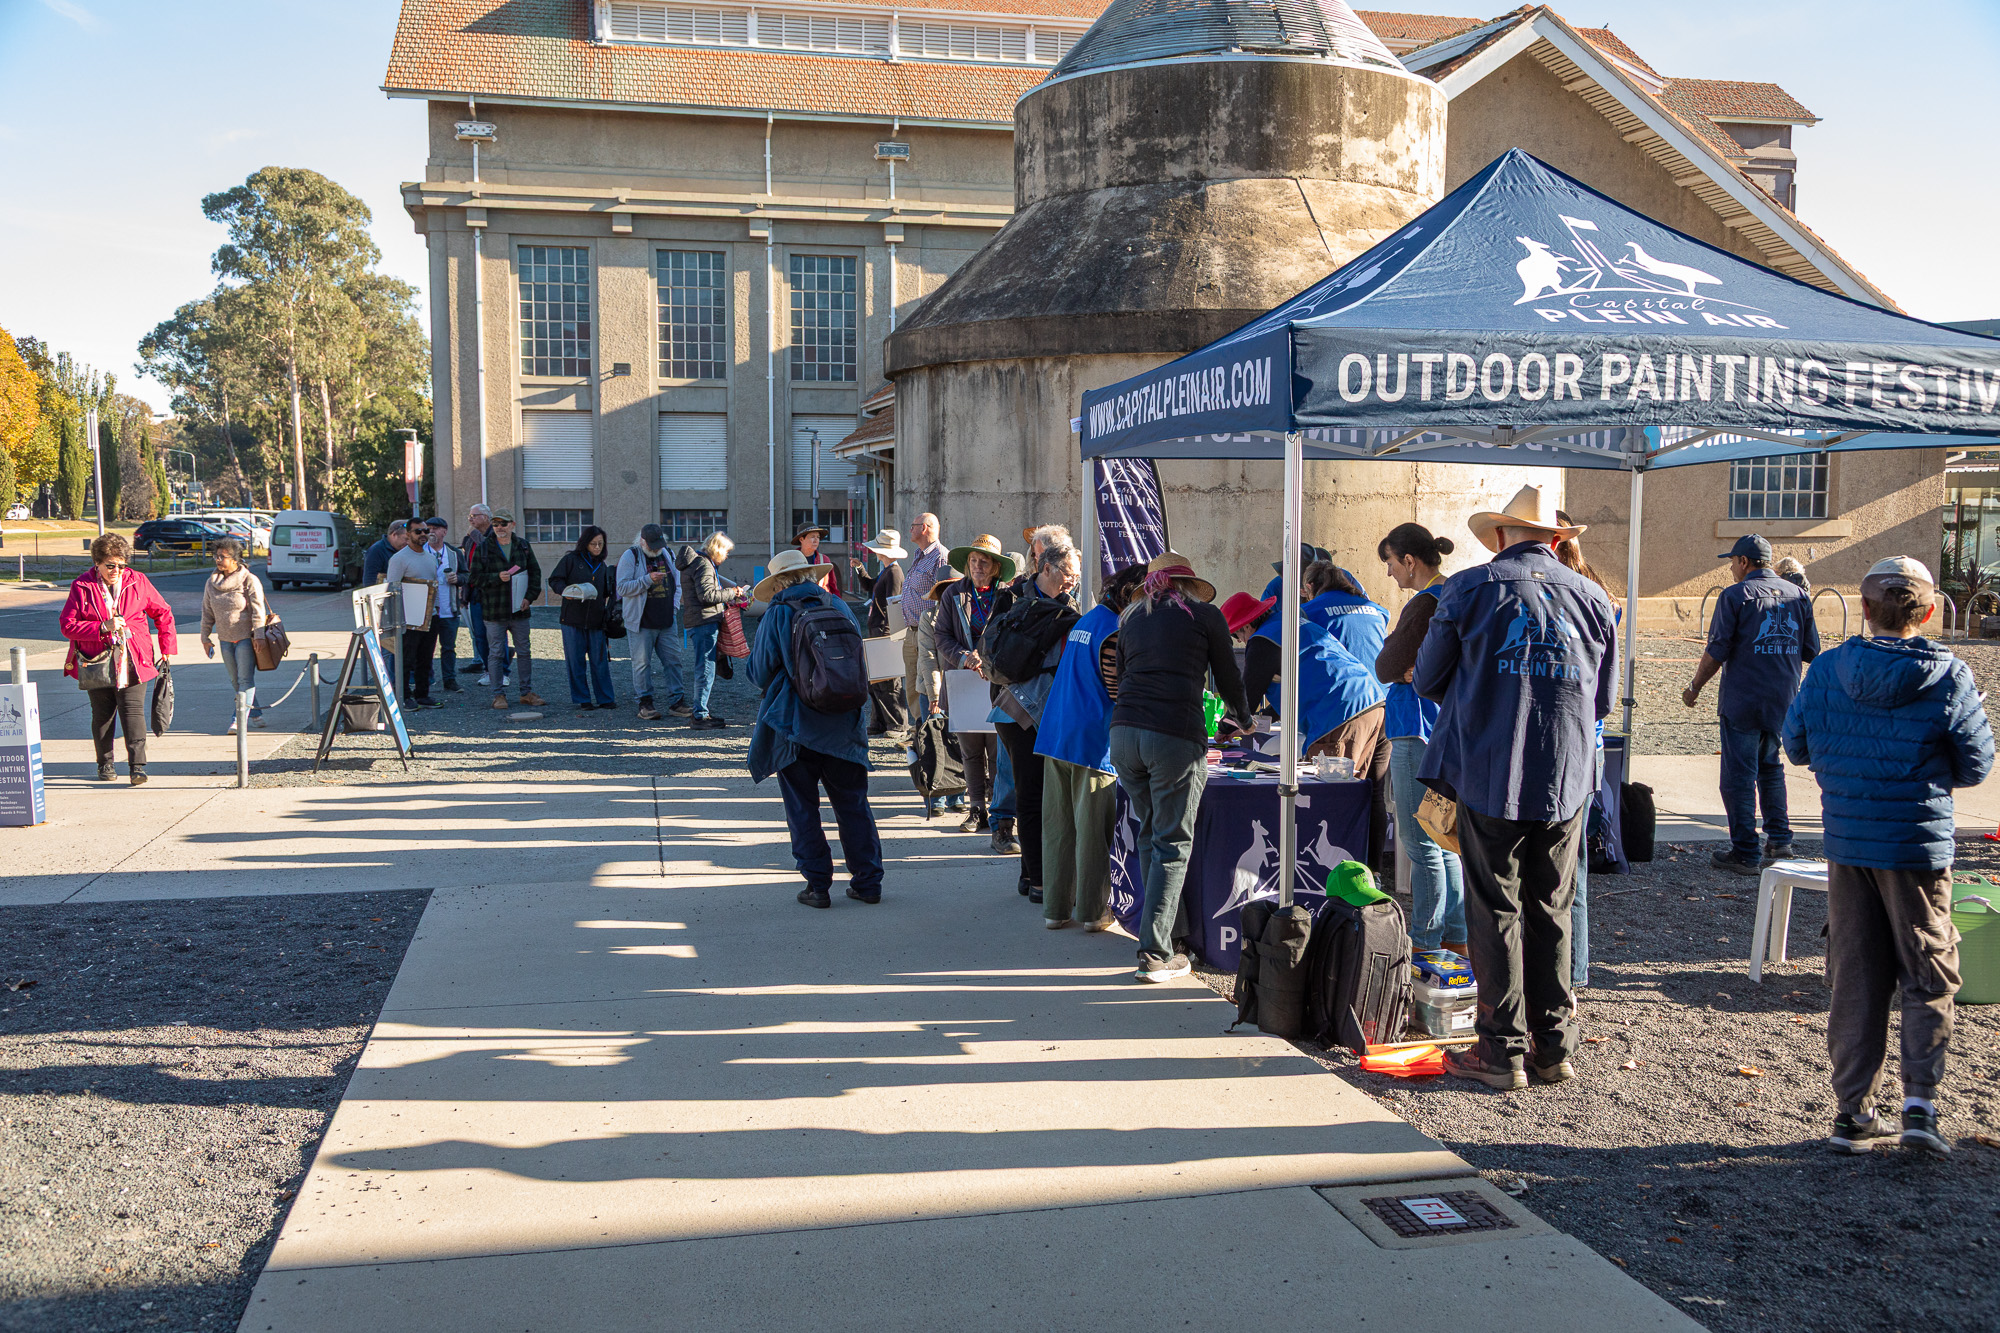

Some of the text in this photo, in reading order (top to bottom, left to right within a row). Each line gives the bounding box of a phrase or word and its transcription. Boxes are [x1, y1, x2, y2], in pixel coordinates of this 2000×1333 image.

[1568, 294, 1706, 311] Capital
[1534, 308, 1790, 329] PLEIN AIR
[1338, 353, 1584, 402] OUTDOOR
[1602, 353, 1829, 406] PAINTING
[1089, 356, 1272, 440] WWW.CAPITALPLEINAIR.COM
[1754, 645, 1799, 655] PLEIN AIR
[1497, 659, 1581, 679] PLEIN AIR
[1448, 975, 1470, 986] Reflex
